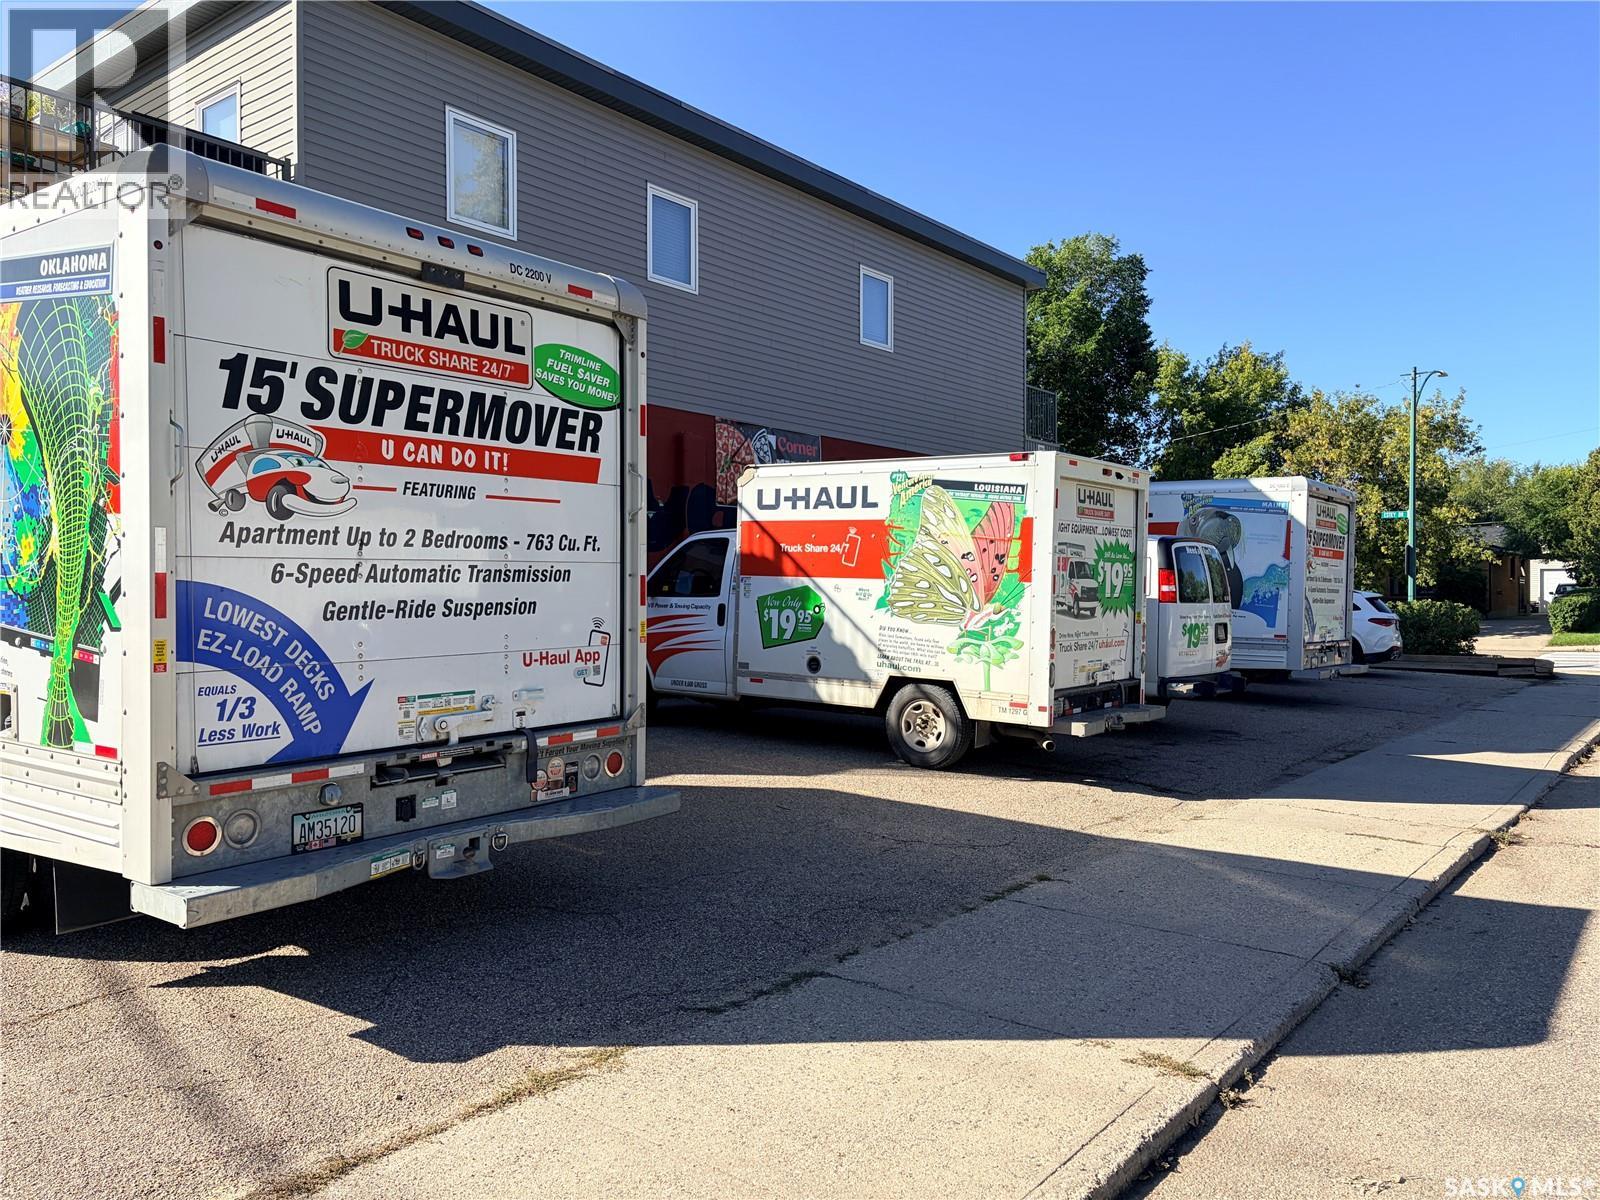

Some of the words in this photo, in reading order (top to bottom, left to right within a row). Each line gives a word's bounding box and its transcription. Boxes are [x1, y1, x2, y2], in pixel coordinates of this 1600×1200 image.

[39, 252, 107, 276] OKLAHOMA
[509, 263, 523, 276] DC
[525, 267, 544, 283] 2200
[370, 339, 425, 363] TRUCK
[428, 350, 479, 372] SHARE
[482, 360, 511, 378] 24/7
[559, 349, 602, 371] TRIMLINE
[546, 358, 574, 375] FUEL
[577, 368, 610, 388] SAVER
[535, 368, 565, 386] SAVES
[567, 380, 586, 393] YOU
[587, 385, 619, 403] MONEY
[218, 352, 299, 414] 15'
[300, 366, 603, 454] SUPERMOVER
[211, 435, 241, 463] U-HAUL
[275, 429, 312, 447] U-HAUL
[777, 436, 818, 457] Corner
[381, 438, 395, 460] U
[402, 442, 443, 464] CAN
[451, 447, 477, 468] DO
[484, 451, 510, 472] IT!
[402, 481, 477, 500] FEATURING
[973, 483, 1023, 494] LOUISIANA
[1077, 488, 1114, 508] U-HAUL
[218, 521, 340, 548] Apartment
[346, 526, 371, 551] Up
[379, 527, 398, 548] to
[403, 528, 416, 548] 2
[421, 529, 509, 550] Bedrooms
[526, 533, 554, 551] 763
[558, 534, 580, 552] Cu.
[583, 535, 601, 552] Ft.
[1058, 522, 1071, 533] IGHT
[779, 543, 803, 553] Truck
[804, 543, 829, 553] Share
[830, 542, 850, 555] 24/7
[1313, 530, 1346, 550] SUPERMOVER
[270, 562, 360, 588] 6-Speed
[364, 563, 462, 584] Automatic
[467, 564, 571, 583] Transmission
[322, 599, 436, 621] Gentle-Ride
[441, 597, 537, 620] Suspension
[203, 597, 289, 648] LOWEST
[284, 639, 336, 701] DECKS
[522, 650, 570, 668] U-Haul
[574, 648, 601, 667] App
[1059, 643, 1073, 652] Truck
[1074, 641, 1087, 651] Share
[876, 661, 922, 673] uhaul.com
[196, 628, 284, 683] EZ-LOAD
[279, 677, 322, 735] RAMP
[197, 684, 237, 697] EQUALS
[216, 696, 257, 722] 1/3
[198, 727, 236, 744] Less
[241, 721, 281, 739] Work
[299, 814, 356, 843] AM35120
